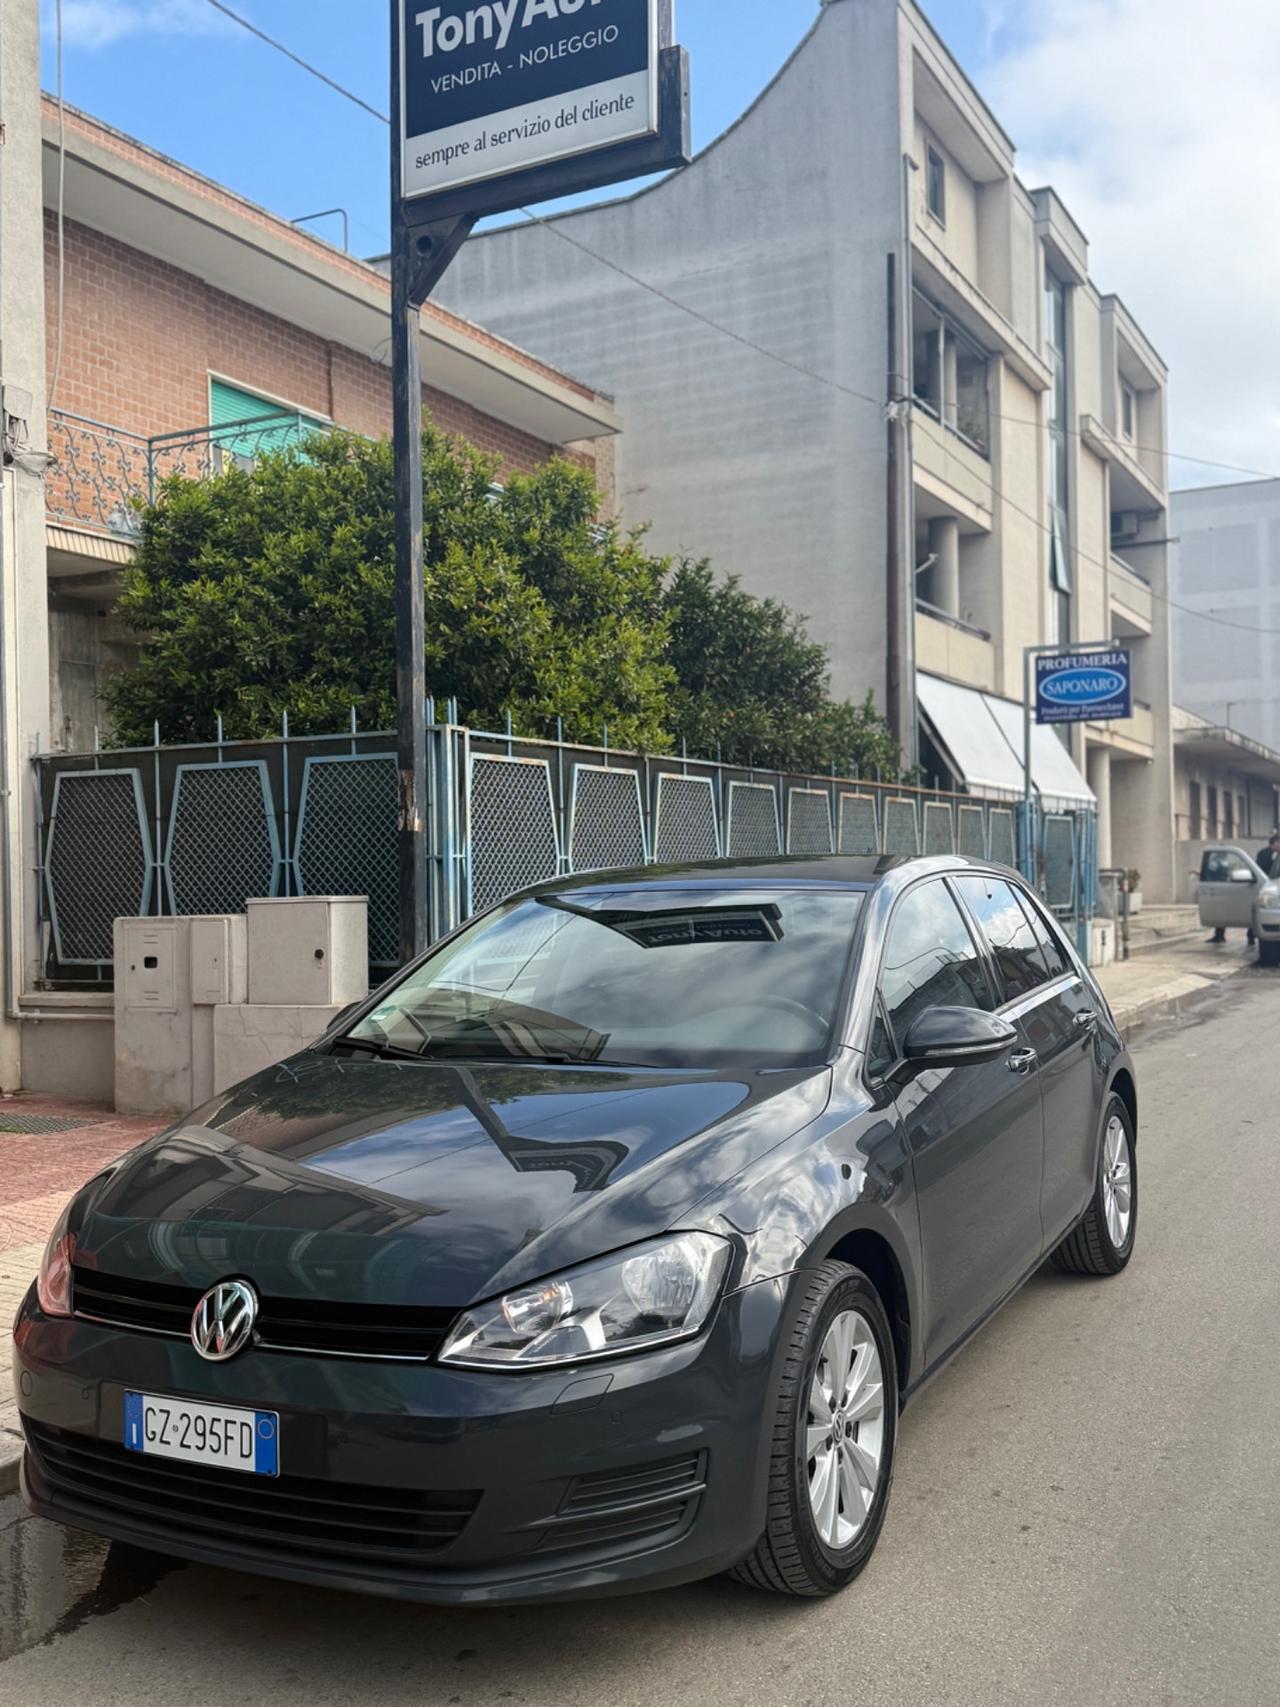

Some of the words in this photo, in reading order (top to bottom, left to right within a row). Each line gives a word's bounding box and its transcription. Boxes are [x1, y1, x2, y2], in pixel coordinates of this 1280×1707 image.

[431, 61, 502, 94] VENDITA
[519, 24, 619, 69] NOLEGGIO
[415, 140, 470, 169] sempre
[474, 131, 487, 151] al
[490, 115, 551, 147] servizio
[554, 105, 578, 130] del
[582, 93, 635, 121] cliente
[1038, 653, 1127, 671] PROFUMERIA
[1046, 677, 1118, 696] SAPONARO
